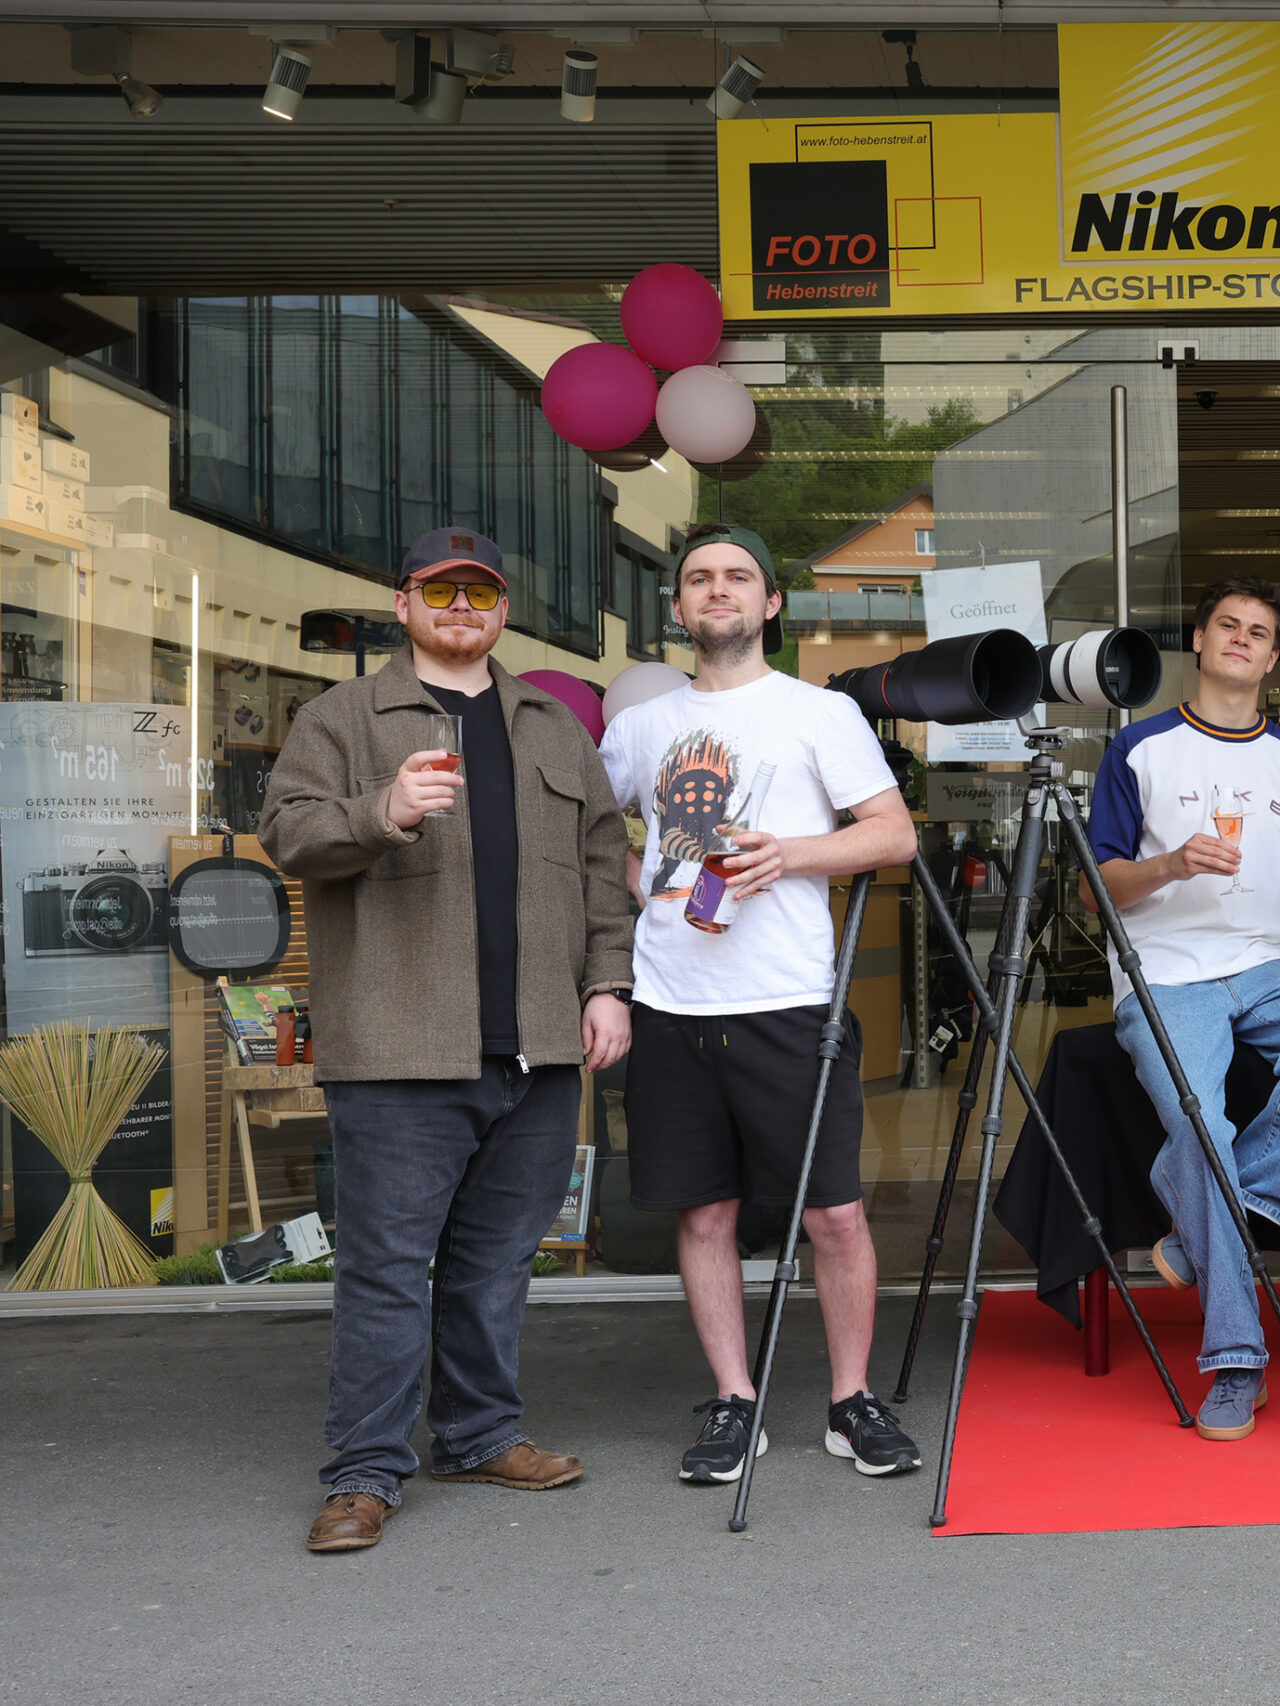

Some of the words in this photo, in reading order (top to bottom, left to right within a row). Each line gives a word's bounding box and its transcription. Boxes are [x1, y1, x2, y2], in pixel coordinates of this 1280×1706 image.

[800, 133, 928, 148] www.foto-hebenstreit.at
[766, 234, 877, 267] FOTO
[766, 280, 879, 300] Hebenstreit
[950, 600, 1018, 619] Geöffnet
[26, 798, 97, 807] GESTALTEN
[104, 797, 121, 806] SIE
[128, 797, 155, 806] IHRE
[26, 811, 126, 820] EINZIGARTIGEN
[132, 810, 184, 820] MOMENTE
[97, 861, 129, 869] Nikon
[119, 1116, 153, 1126] EHBARER
[110, 1130, 149, 1140] UETOOTH®
[153, 1220, 173, 1235] Nik
